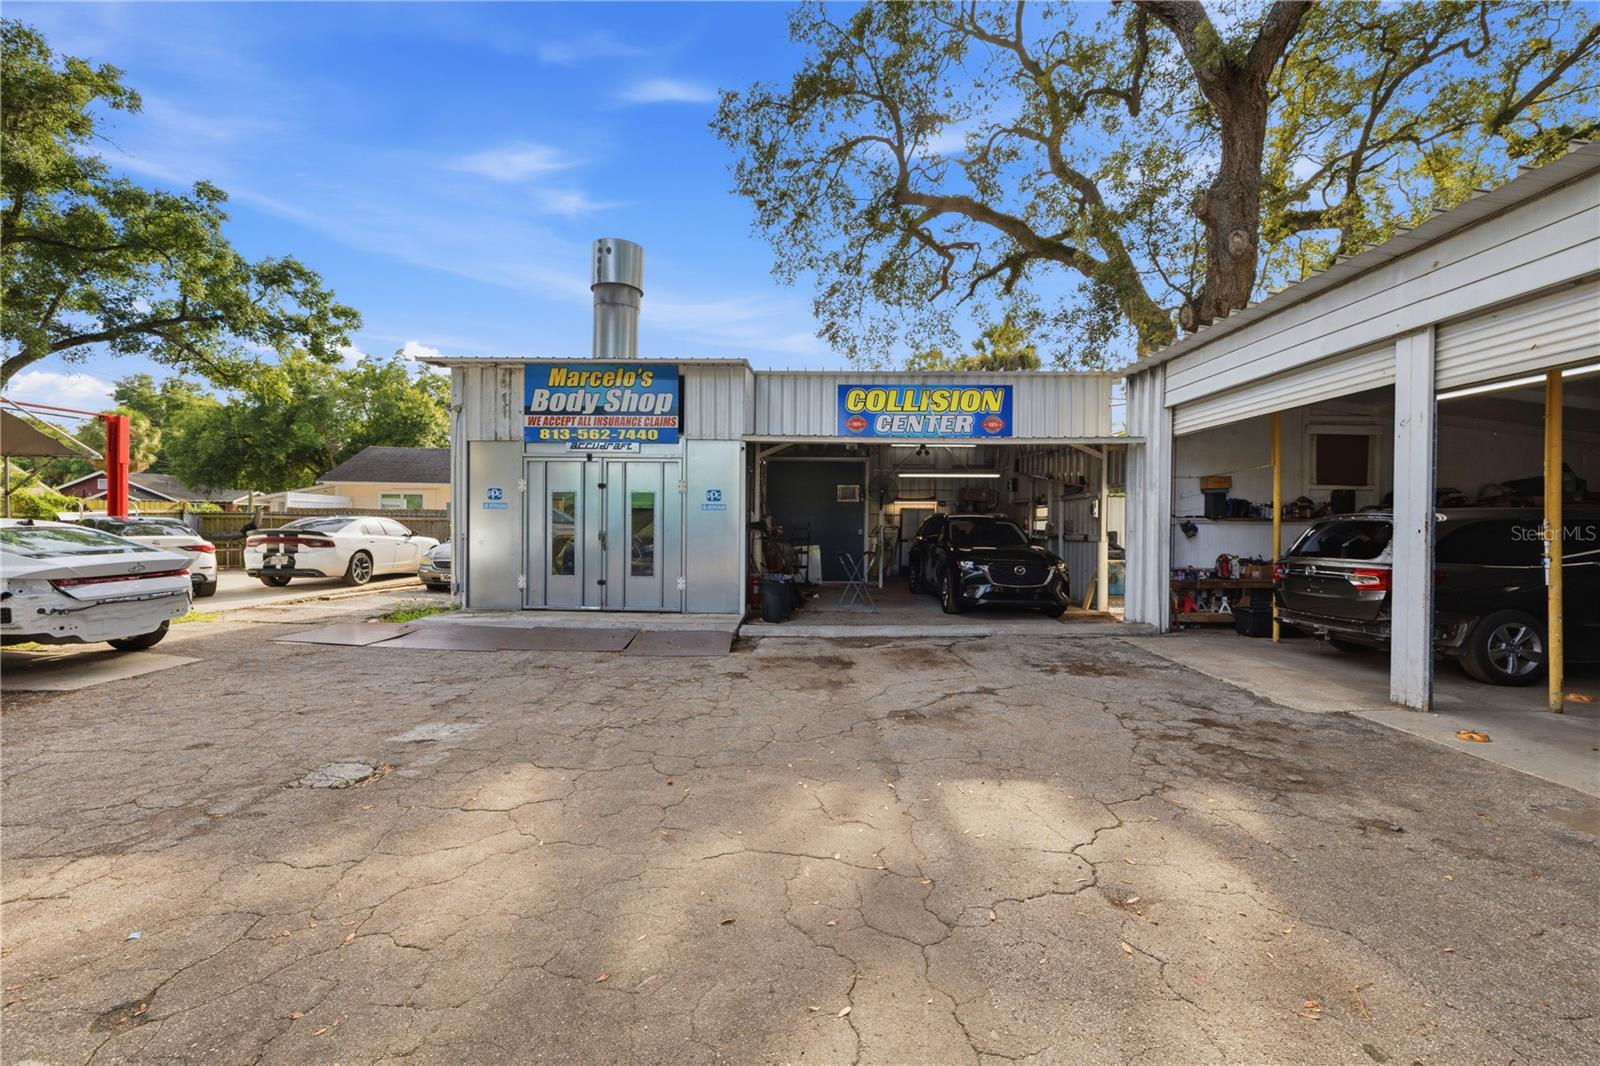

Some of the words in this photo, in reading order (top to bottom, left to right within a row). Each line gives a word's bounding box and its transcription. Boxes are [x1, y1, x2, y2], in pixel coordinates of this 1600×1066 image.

[549, 368, 653, 387] Marcelo's
[530, 389, 600, 414] Body
[603, 389, 673, 414] Shop
[846, 388, 1004, 413] COLLISION
[528, 416, 541, 426] WE
[544, 416, 576, 426] ACCEPT
[578, 416, 591, 426] ALL
[593, 416, 642, 426] INSURANCE
[644, 416, 677, 427] CLAIMS
[875, 414, 974, 433] CENTER
[539, 429, 658, 440] 813-562-7440
